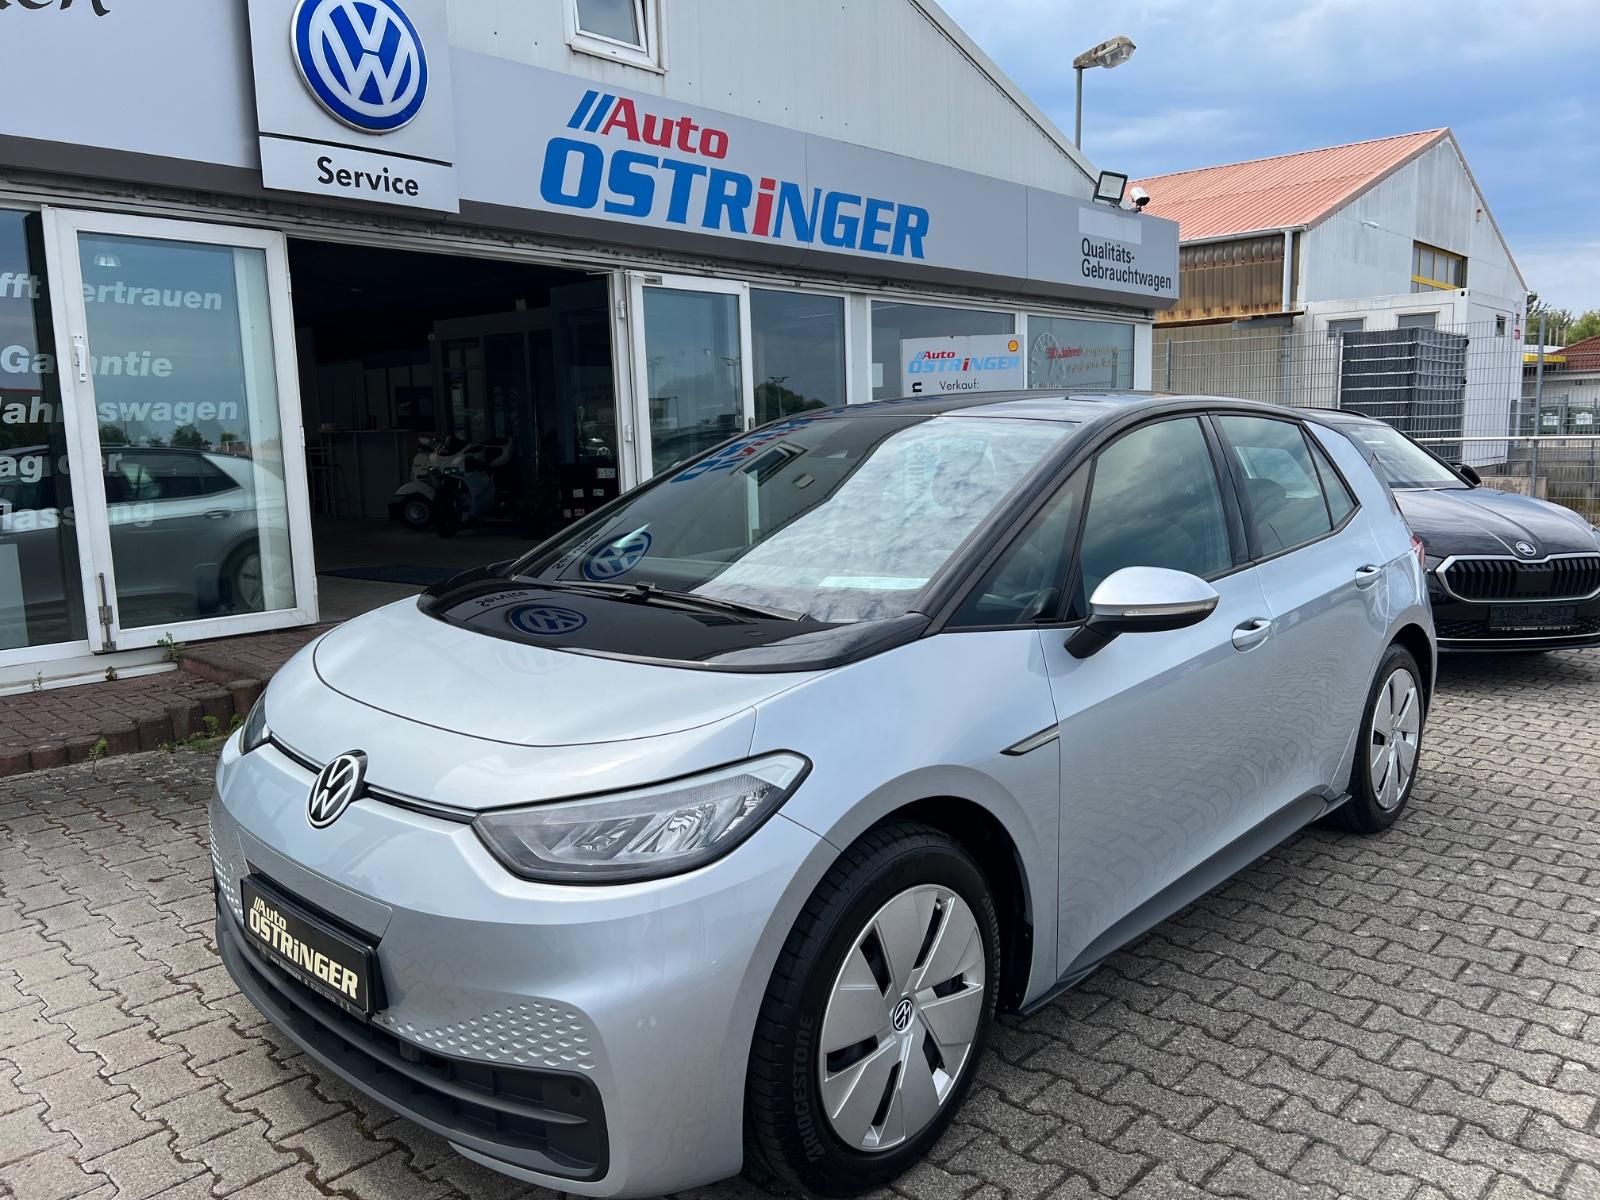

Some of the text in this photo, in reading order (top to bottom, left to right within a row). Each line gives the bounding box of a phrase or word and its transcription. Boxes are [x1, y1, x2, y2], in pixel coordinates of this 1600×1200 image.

[317, 156, 419, 197] Service
[540, 137, 929, 259] OSTRiNGER
[1081, 238, 1135, 264] Qualitäts-
[1081, 259, 1172, 291] Gebrauchtwagen
[81, 281, 222, 310] ertrauen
[908, 357, 1020, 375] OSTRiNGER
[939, 380, 980, 392] Verkauf:
[250, 908, 358, 1000] OSTRiNGER
[793, 1014, 824, 1163] BRIDGESTONE
